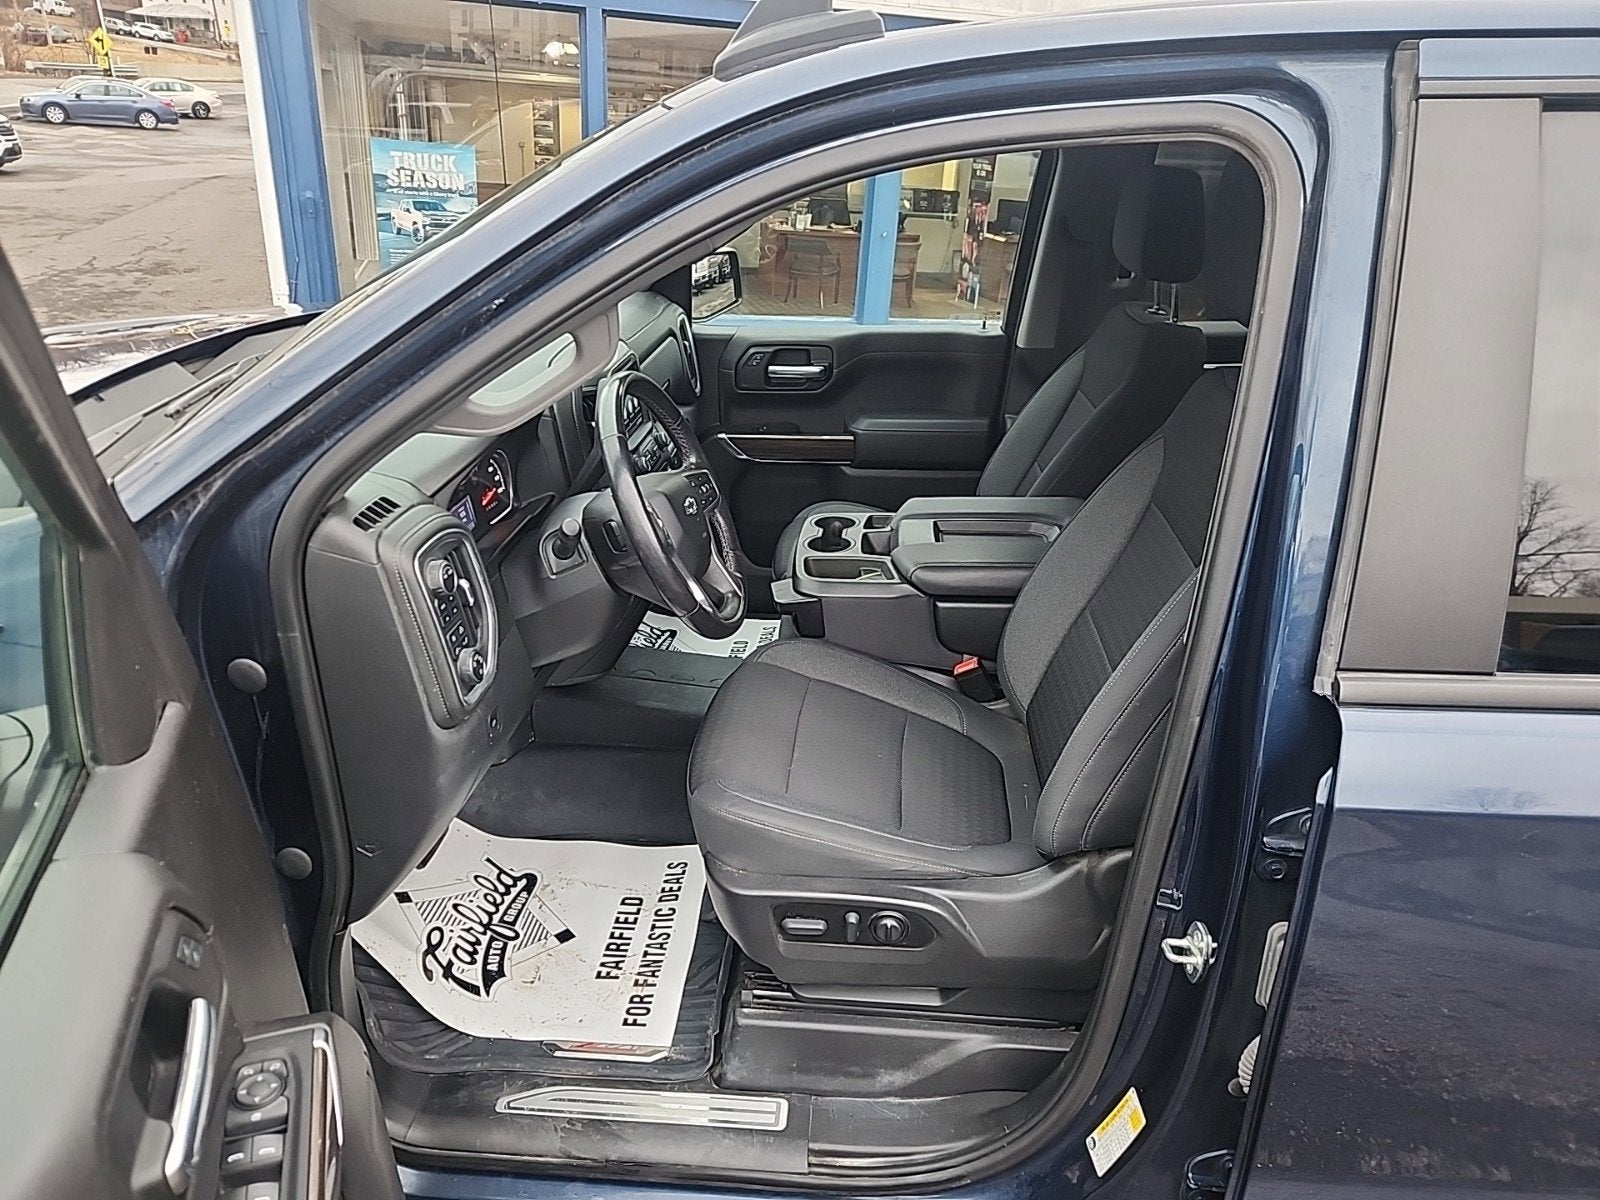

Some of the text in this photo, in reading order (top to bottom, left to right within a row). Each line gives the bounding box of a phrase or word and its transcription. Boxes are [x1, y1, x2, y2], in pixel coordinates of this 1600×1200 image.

[386, 168, 465, 191] SEASON
[390, 151, 457, 173] TRUCK
[422, 857, 534, 997] Fairfield
[486, 891, 529, 972] AUTO GROUP
[594, 896, 644, 980] FAIRFIELD
[622, 861, 689, 1027] FOR FANTASTIC DEALS
